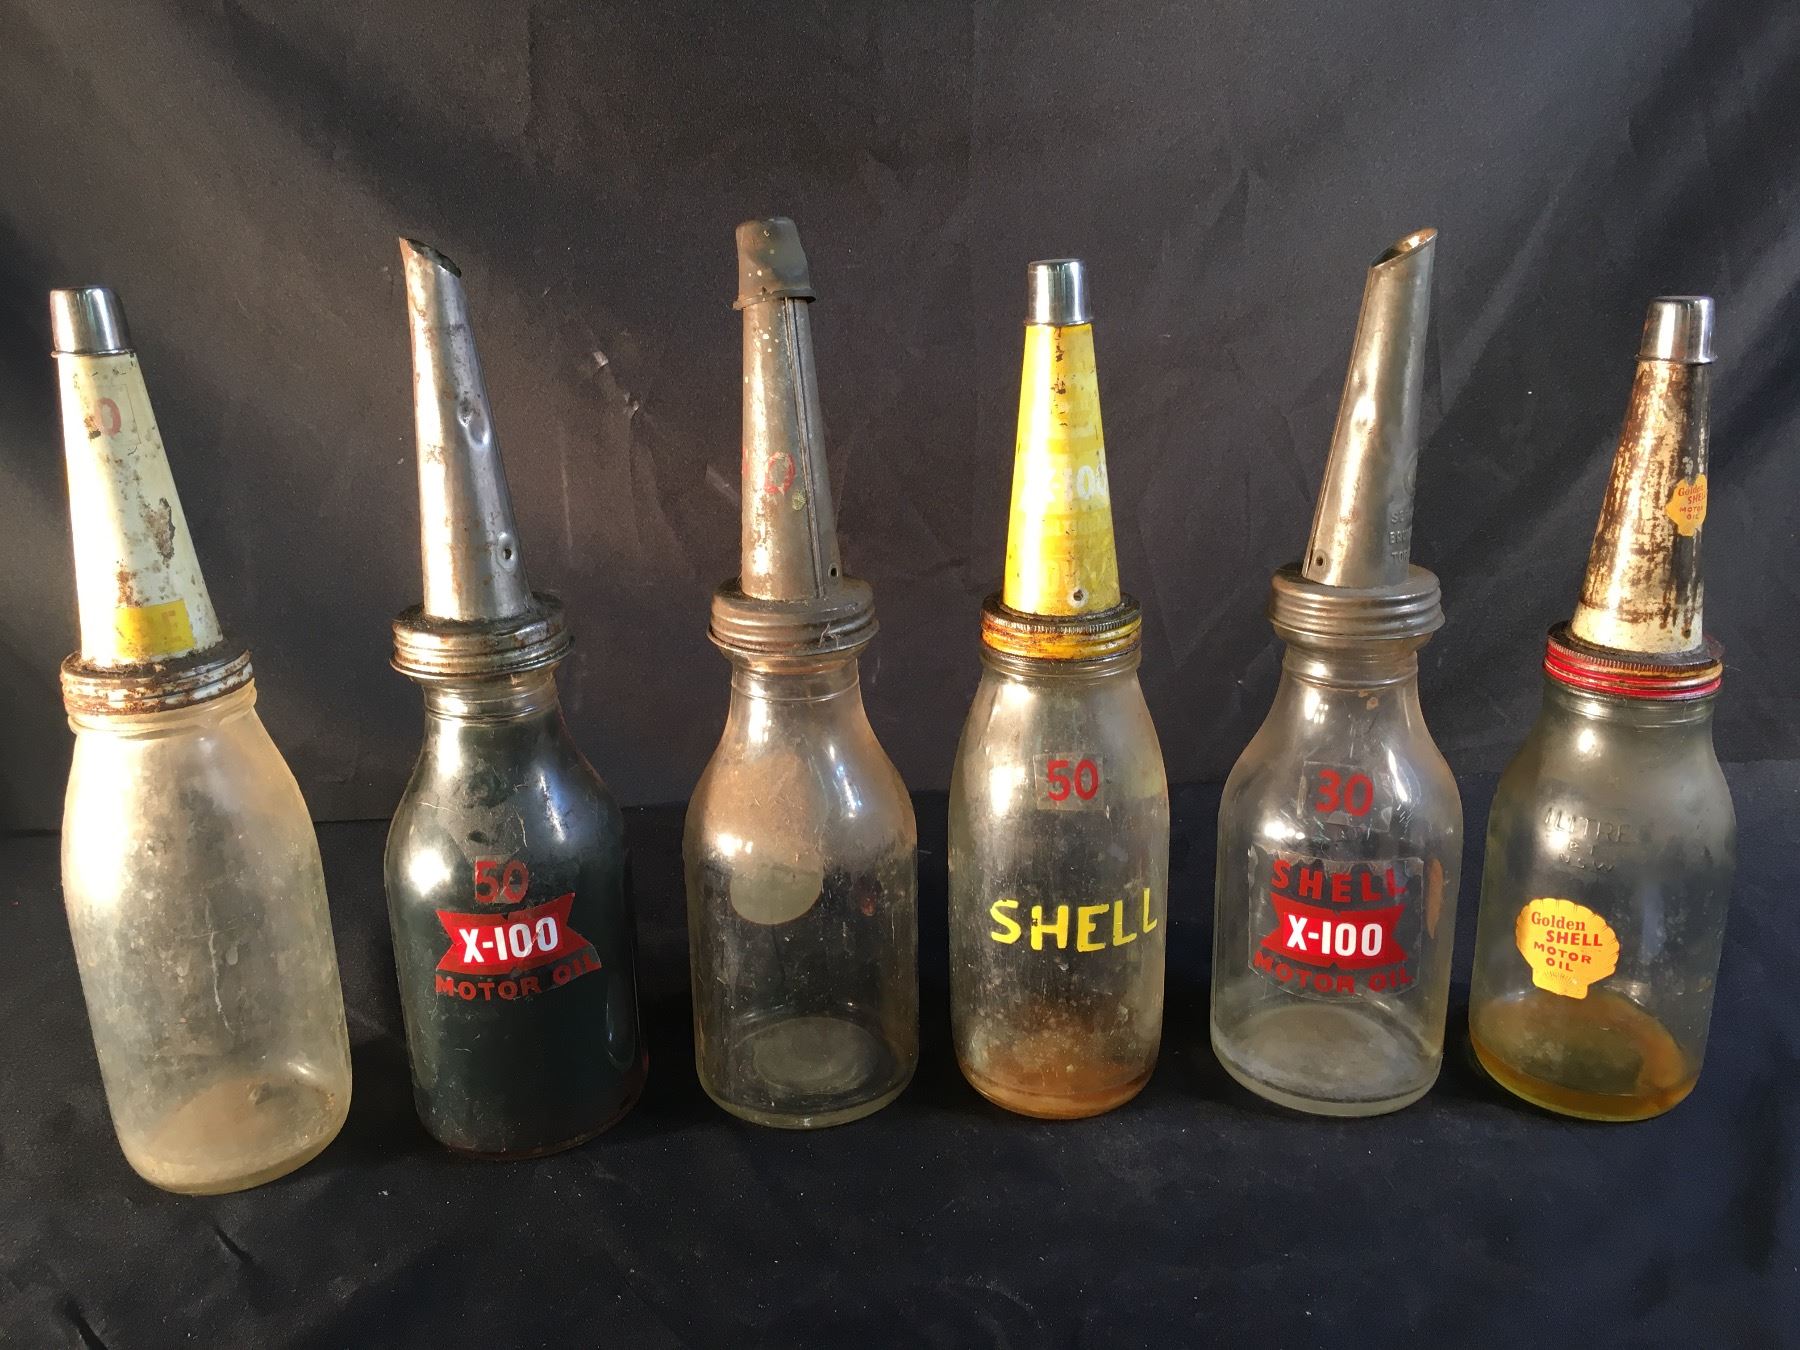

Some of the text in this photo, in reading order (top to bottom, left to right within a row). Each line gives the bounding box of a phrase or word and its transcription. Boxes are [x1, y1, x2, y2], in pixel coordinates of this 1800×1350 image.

[1047, 759, 1099, 801] 50
[1315, 768, 1374, 817] 30
[475, 859, 530, 903] 50
[1271, 859, 1408, 903] SHELL
[458, 916, 559, 964] X-100
[989, 887, 1158, 952] SHELL
[1286, 914, 1383, 957] X-100
[1531, 911, 1586, 932] Golden
[1546, 930, 1603, 947] SHELL
[1253, 951, 1413, 994] MOTOR OIL
[1534, 941, 1592, 965] MOTOR
[1545, 957, 1574, 972] OIL
[434, 952, 602, 1001] MOTOR OIL
